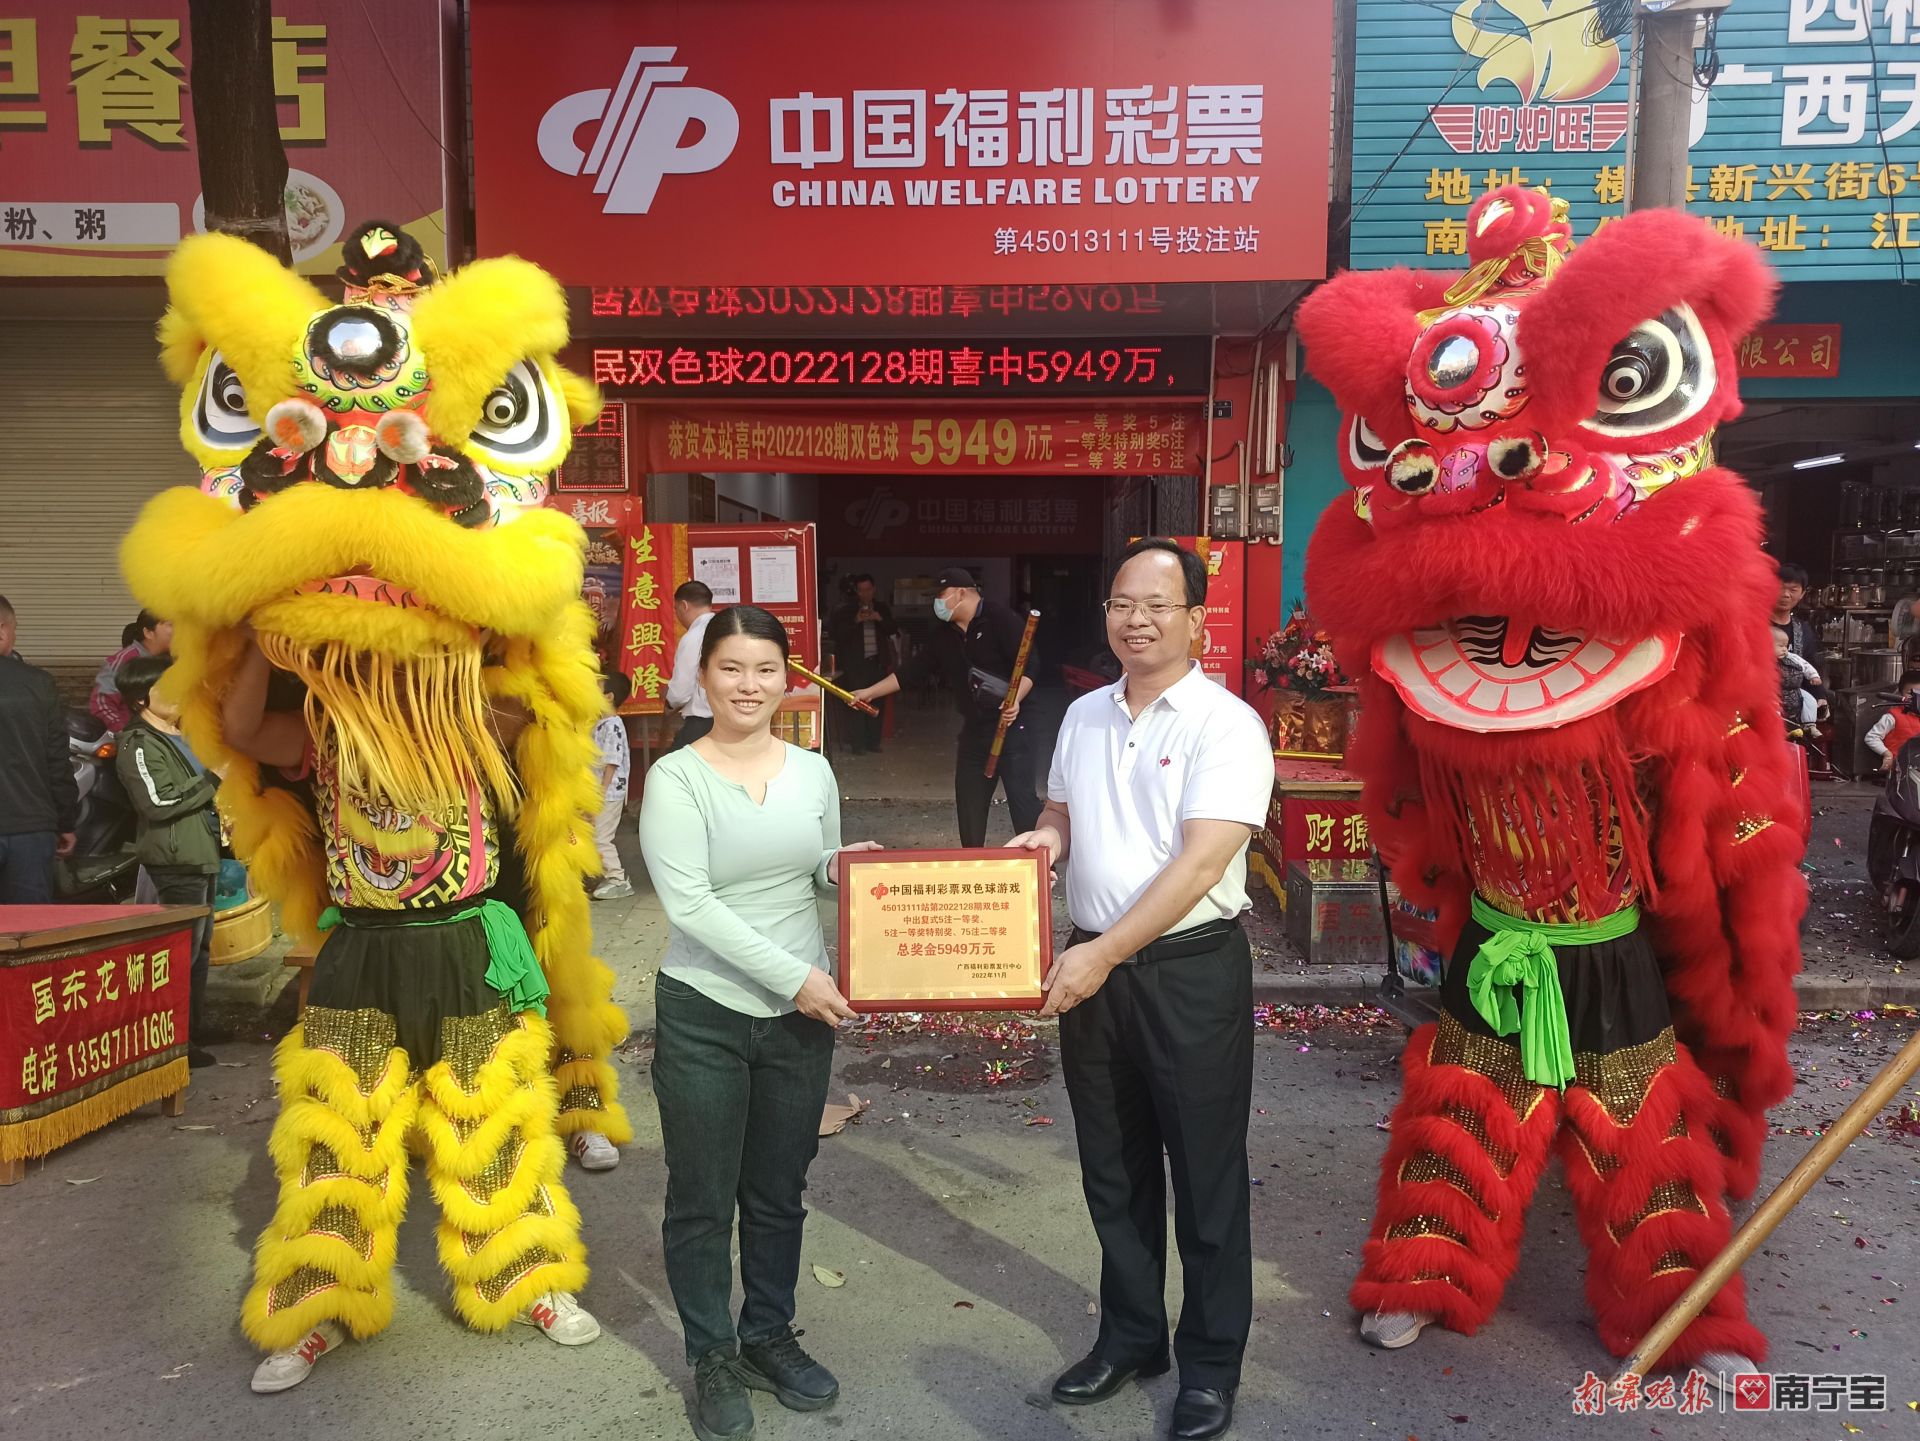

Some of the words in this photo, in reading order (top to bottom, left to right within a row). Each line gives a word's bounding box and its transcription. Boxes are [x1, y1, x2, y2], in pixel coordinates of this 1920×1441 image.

[770, 84, 1264, 169] 中国福利彩票
[1477, 105, 1591, 152] 炉炉旺
[772, 179, 895, 206] CHINA
[904, 177, 1082, 205] WELFARE
[1094, 176, 1260, 204] LOTTERY
[4, 207, 106, 240] 粉、粥
[993, 225, 1260, 255] 第45013111号投注站
[1065, 413, 1185, 431] 一等奖5注
[668, 420, 899, 463] 恭贺本站喜中2022128期双色球
[911, 418, 1017, 465] 5949
[1025, 424, 1053, 462] 万元
[1065, 432, 1185, 450] 一等奖特别奖5注
[1064, 452, 1184, 470] 二等奖75注
[917, 498, 1079, 523] 中国福利彩票
[1305, 813, 1368, 853] 财源
[889, 882, 1021, 896] 中国福利彩票双色球游戏
[881, 902, 1010, 912] 45013111站第2022128期双色球
[884, 927, 1008, 937] 5注一等奖特别奖、75注二等奖
[897, 943, 995, 957] 总奖金5949万元
[32, 949, 170, 1024] 国东龙狮团
[22, 1043, 58, 1095] 电话
[67, 1009, 174, 1080] 13597111605
